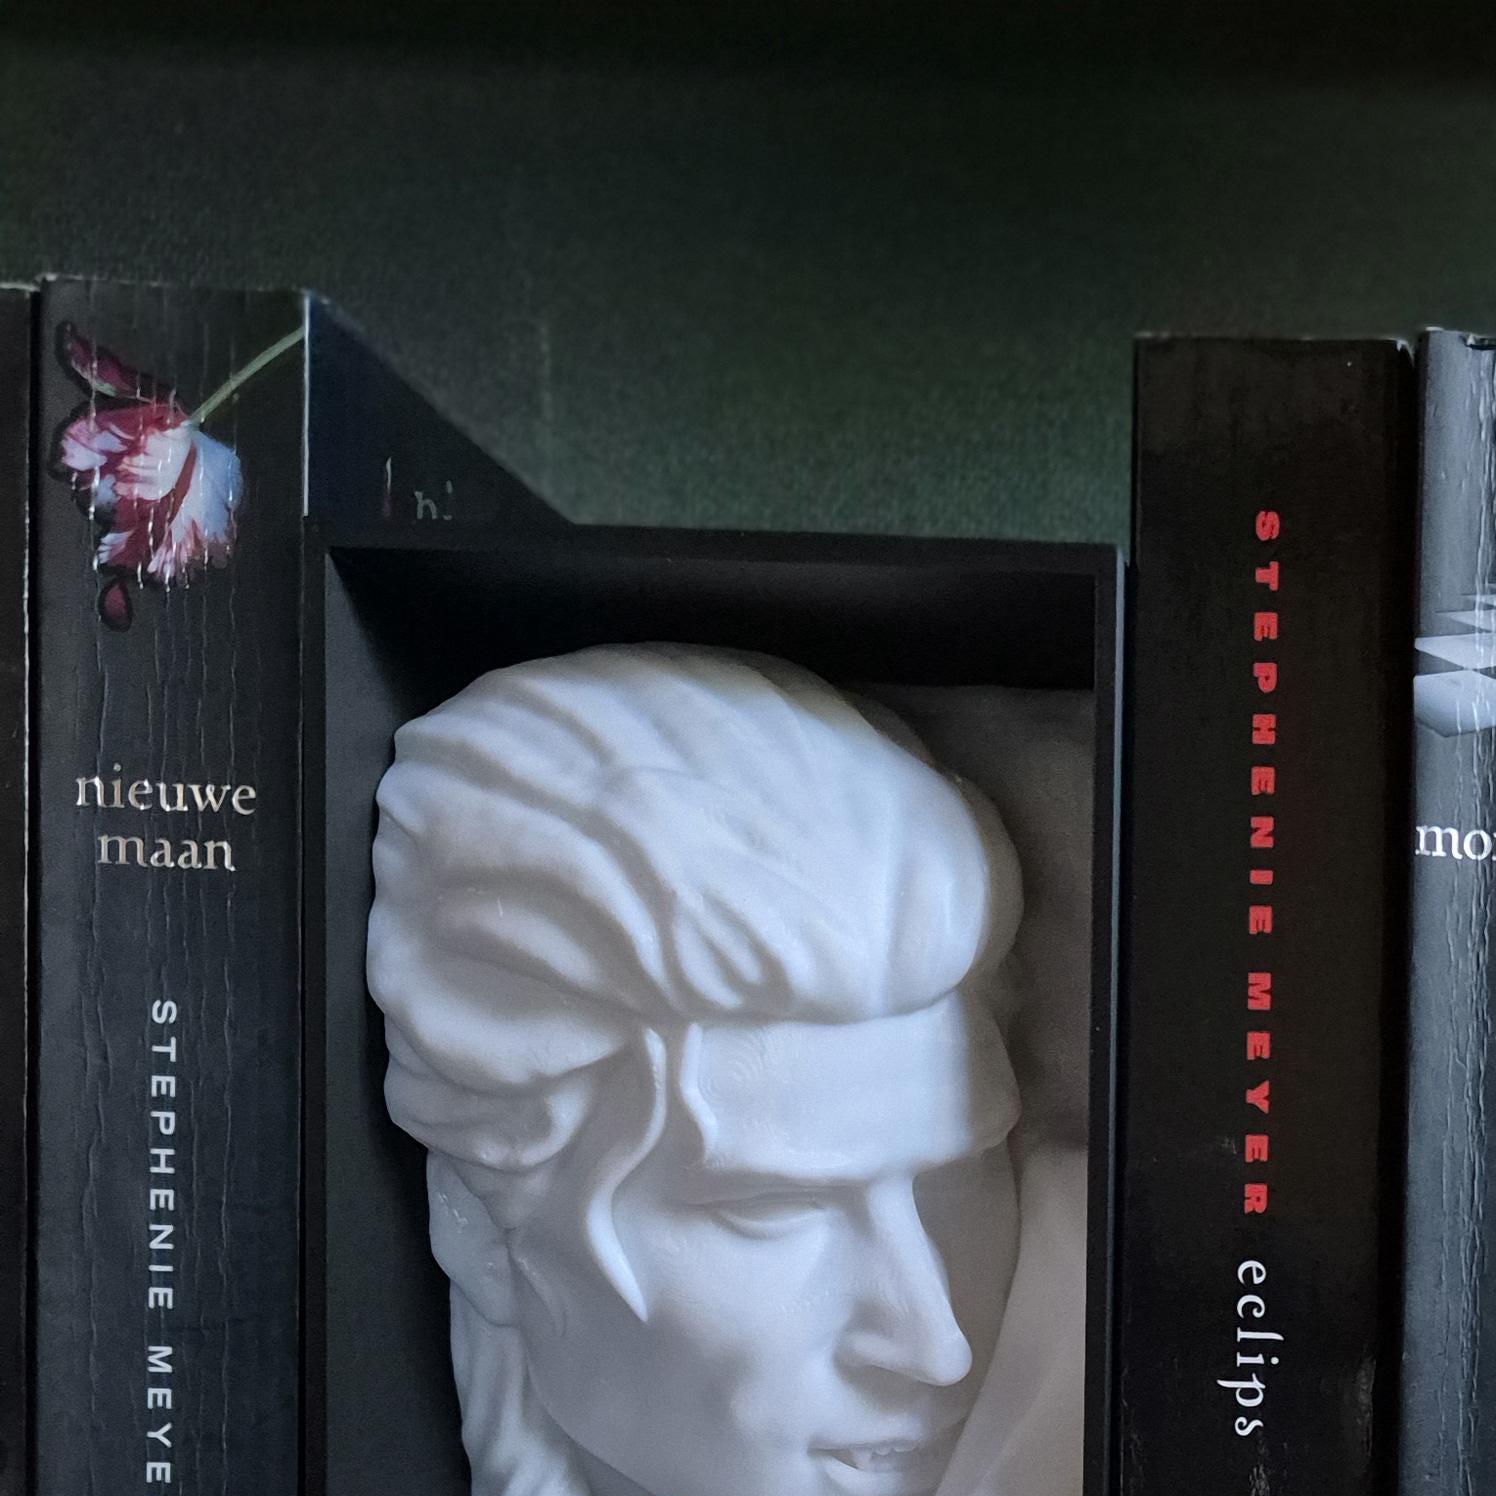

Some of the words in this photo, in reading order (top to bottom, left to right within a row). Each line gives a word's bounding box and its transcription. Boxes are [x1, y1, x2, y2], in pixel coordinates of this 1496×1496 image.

[76, 763, 257, 816] nieuwe
[1248, 509, 1282, 936] STEPHENIE
[98, 834, 237, 873] maan
[149, 999, 178, 1311] STEPHENIE
[1243, 971, 1273, 1215] MEYER
[1217, 1259, 1285, 1438] eclips
